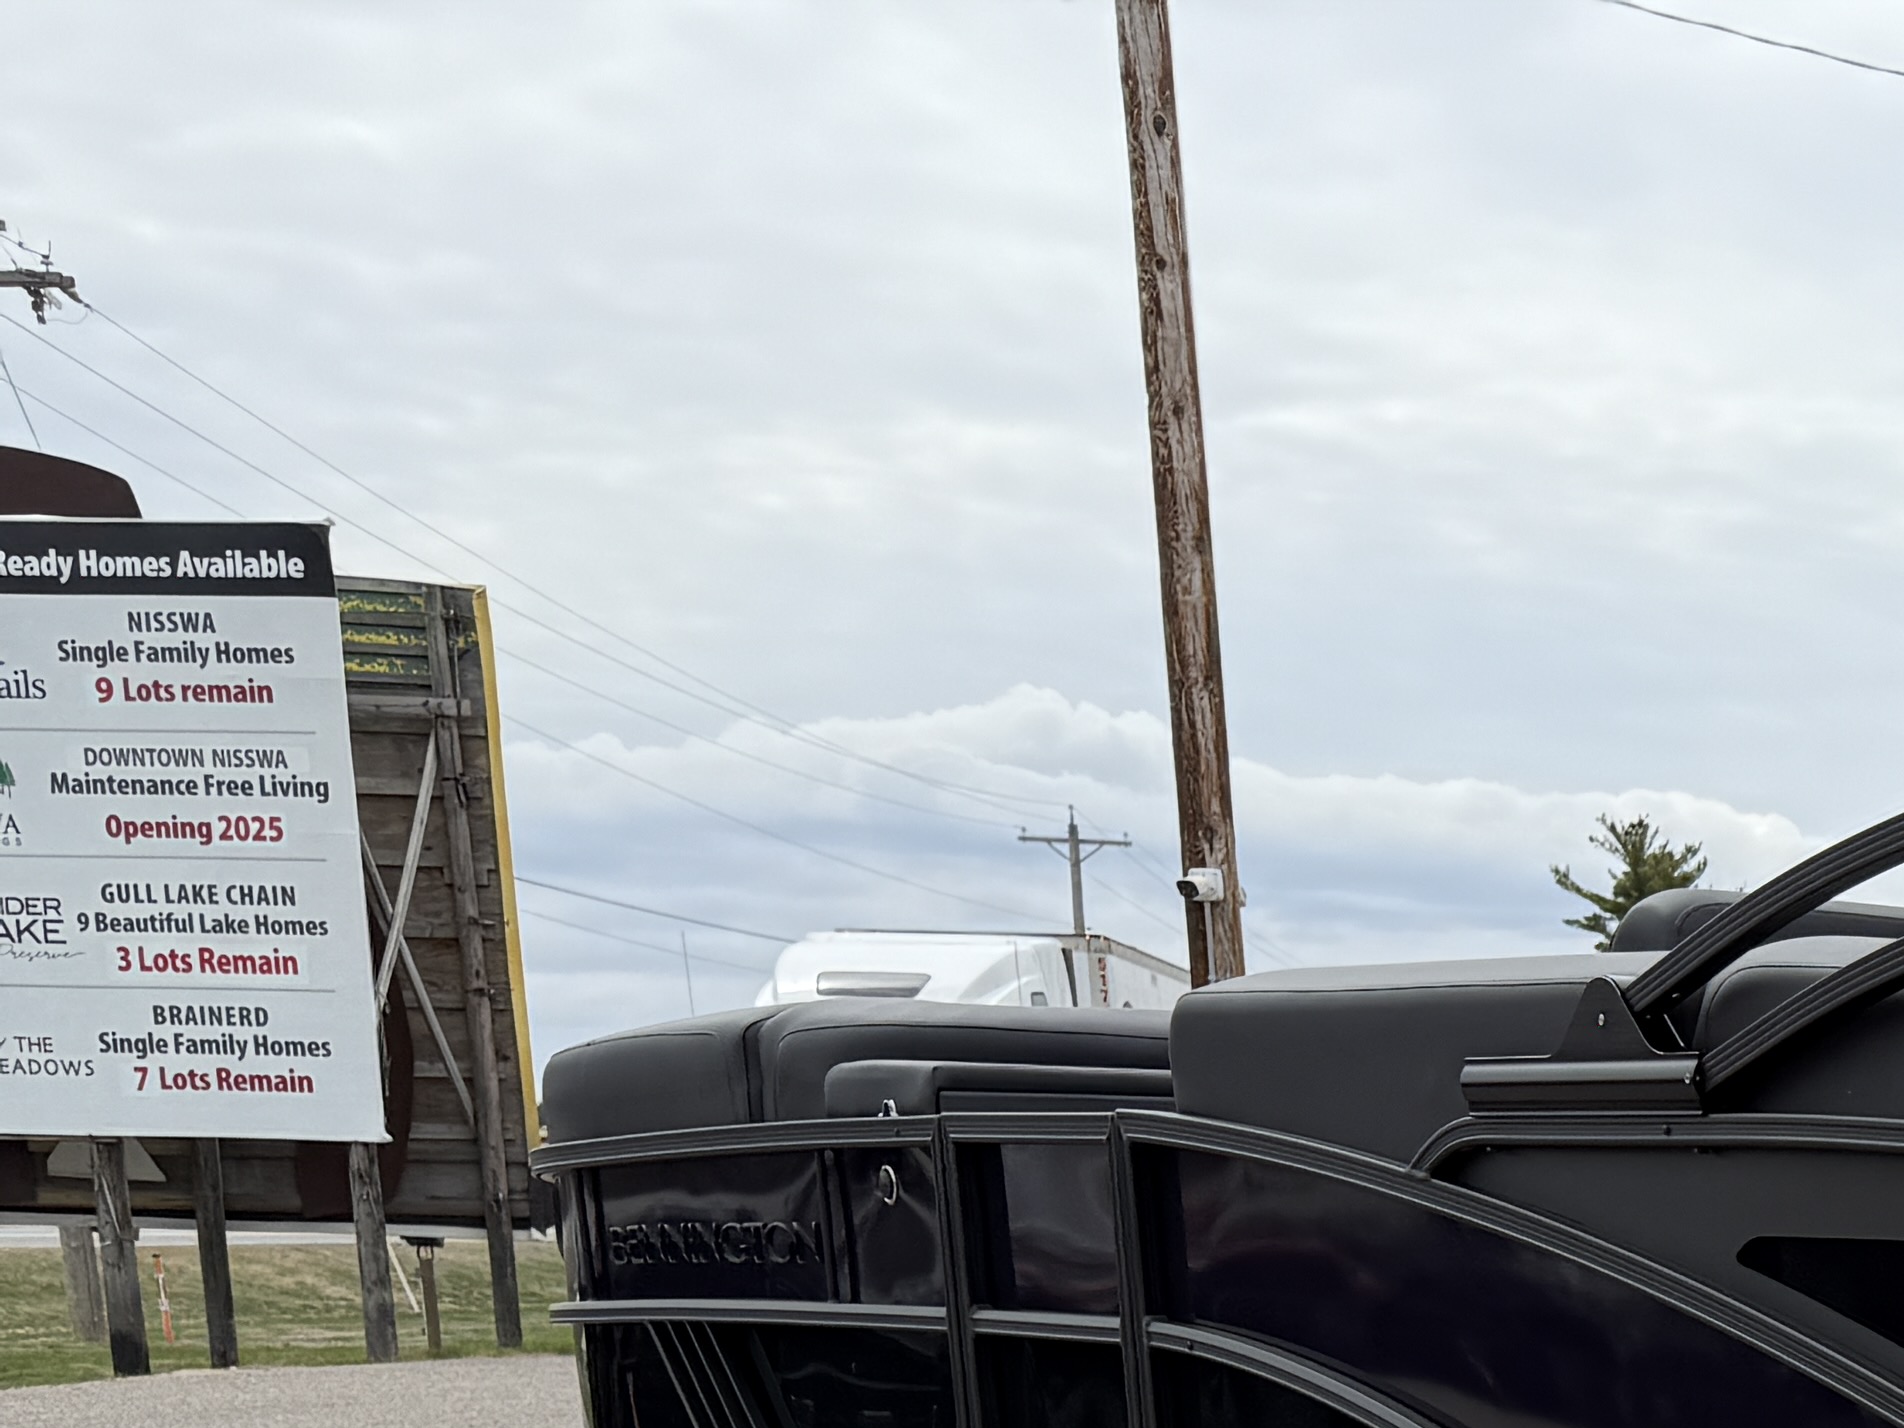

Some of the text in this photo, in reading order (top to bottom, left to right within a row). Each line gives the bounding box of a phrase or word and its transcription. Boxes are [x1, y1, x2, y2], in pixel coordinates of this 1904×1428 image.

[79, 550, 171, 578] Homes
[177, 550, 305, 579] Available
[128, 611, 216, 633] NISSWA
[57, 639, 294, 668] Single Family Homes
[95, 677, 273, 703] 9 Lots remain
[83, 747, 288, 769] DOWNTOWN NISSWA
[50, 772, 329, 803] Maintenance Free Living
[105, 814, 283, 845] Opening 2025
[0, 896, 61, 916] DER
[101, 883, 296, 906] GULL LAKE CHAIN
[77, 912, 328, 936] 9 Beautiful Lake Homes
[116, 946, 298, 975] 3 Lots Remain
[152, 1005, 269, 1027] BRAINERD
[13, 1036, 53, 1053] THE
[98, 1032, 332, 1061] Single Family Homes
[0, 1058, 94, 1076] EADOWS
[133, 1066, 313, 1093] 7 Lots Remain
[609, 1221, 825, 1264] BENNINGTON
